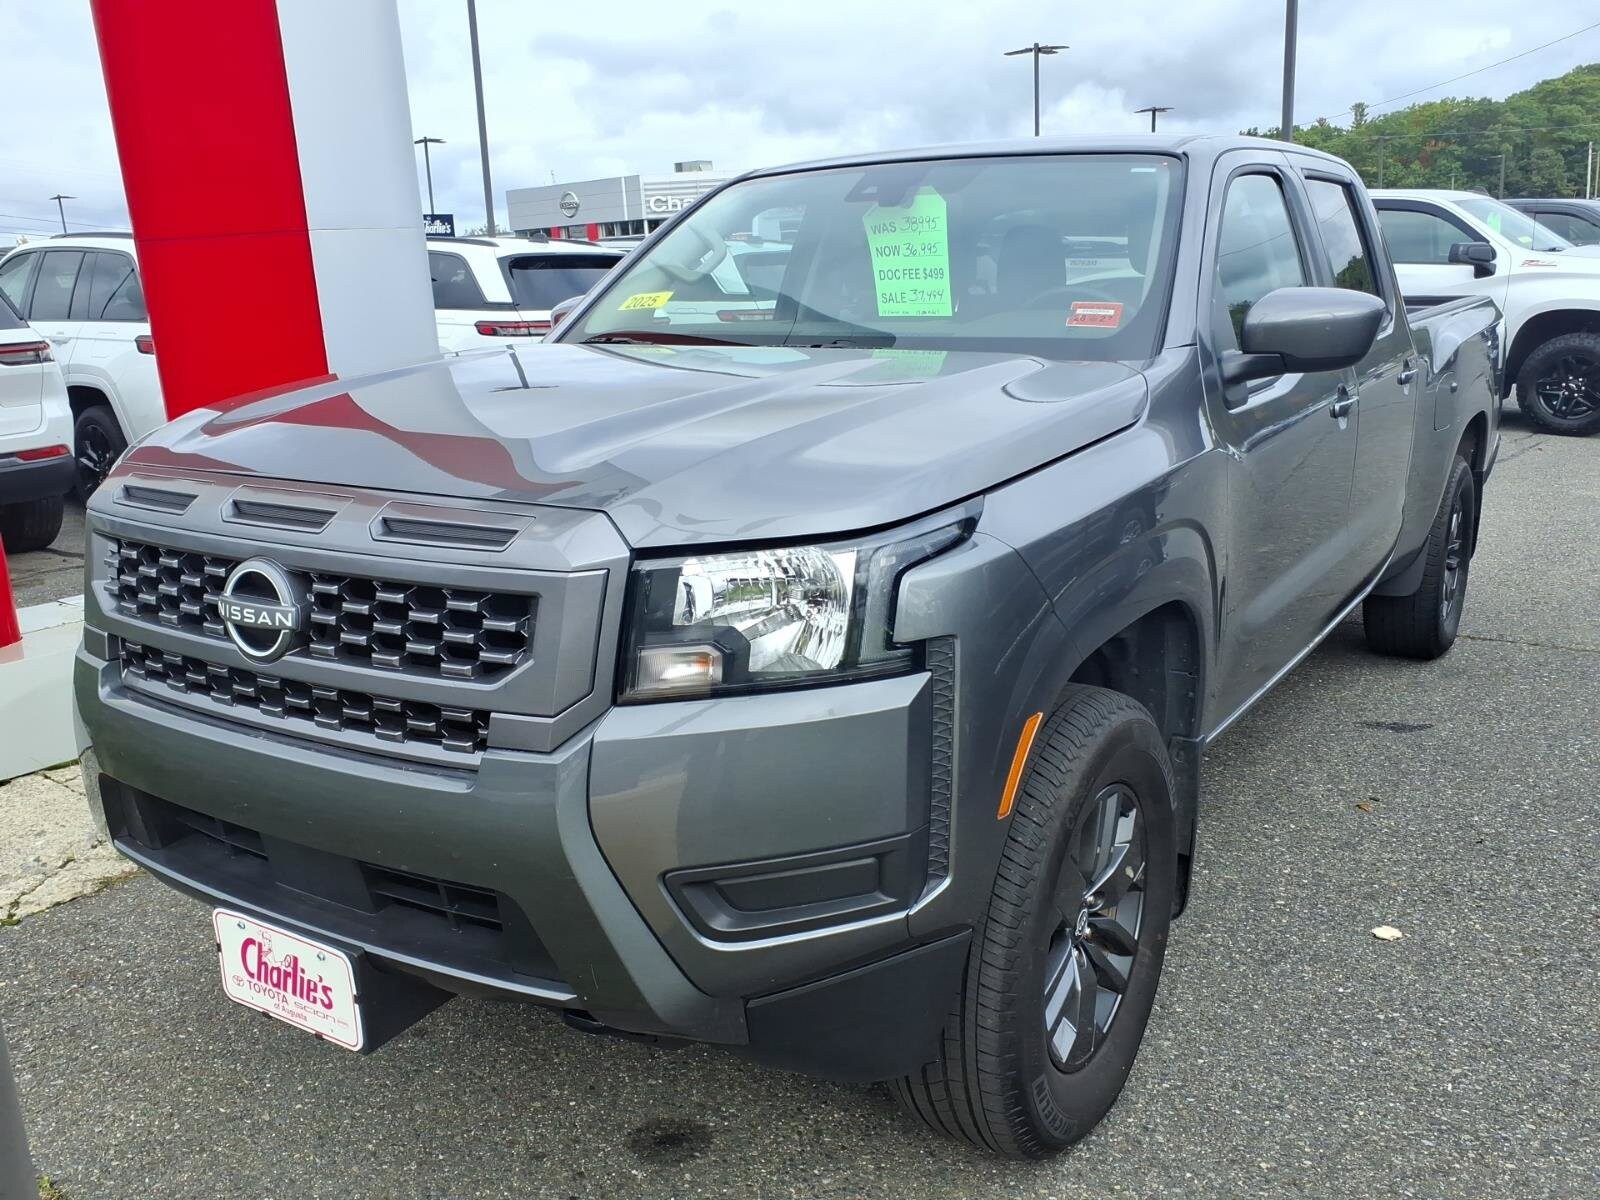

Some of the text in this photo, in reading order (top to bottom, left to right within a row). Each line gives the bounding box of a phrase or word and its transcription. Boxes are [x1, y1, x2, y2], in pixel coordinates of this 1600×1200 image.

[870, 220, 897, 235] WAS
[875, 241, 940, 257] NOW 36,995
[879, 267, 944, 280] DOC FEE $499
[625, 295, 660, 309] 2025
[881, 291, 908, 303] SALE
[217, 599, 293, 627] NISSAN
[240, 937, 334, 1010] Charlie's
[246, 979, 289, 1006] TOYOTA
[281, 1004, 308, 1022] Augusta
